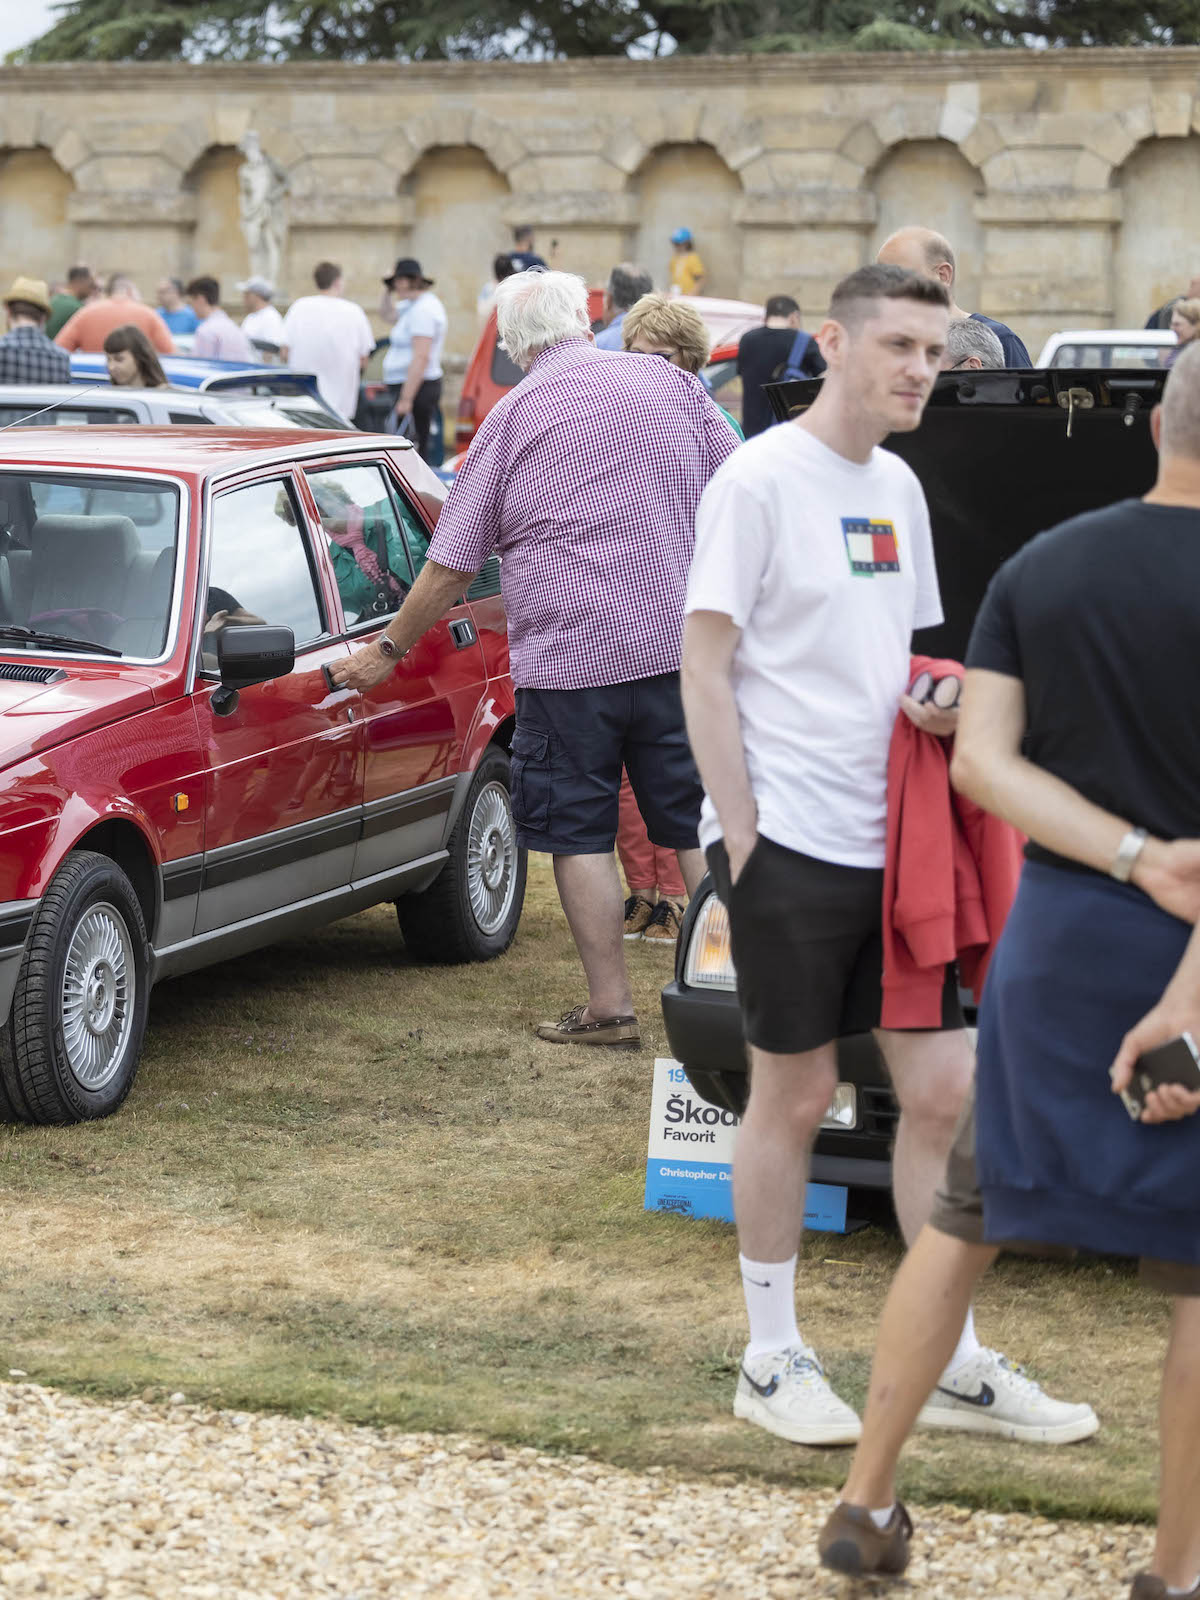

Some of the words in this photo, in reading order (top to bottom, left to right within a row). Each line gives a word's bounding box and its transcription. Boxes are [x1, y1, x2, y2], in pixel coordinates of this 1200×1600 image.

[57, 1053, 89, 1112] MICHELIN
[667, 1068, 690, 1083] 19
[664, 1093, 739, 1127] Škod
[663, 1127, 716, 1144] Favorit
[659, 1167, 717, 1181] Christopher
